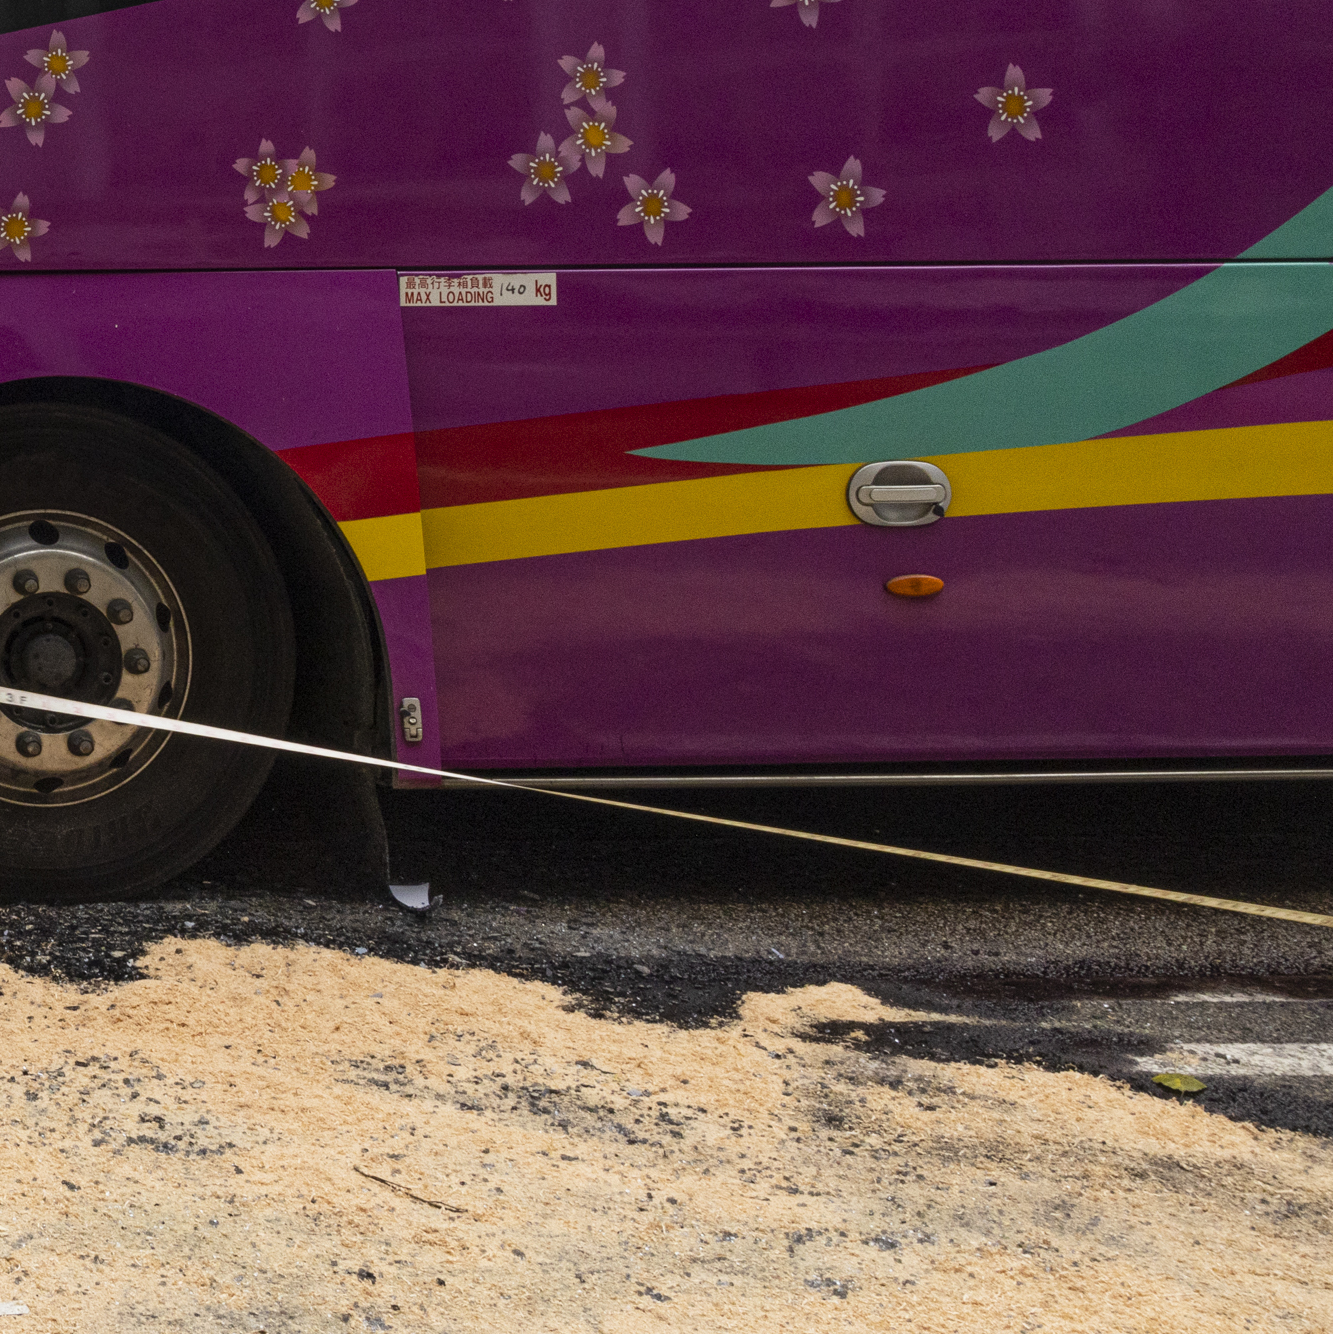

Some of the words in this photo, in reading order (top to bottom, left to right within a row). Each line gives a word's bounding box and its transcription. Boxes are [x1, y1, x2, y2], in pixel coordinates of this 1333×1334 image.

[405, 276, 494, 290] 最高行李箱負載
[499, 282, 527, 297] 140
[404, 291, 432, 304] MAX
[439, 290, 494, 304] LOADING
[534, 280, 552, 302] kg
